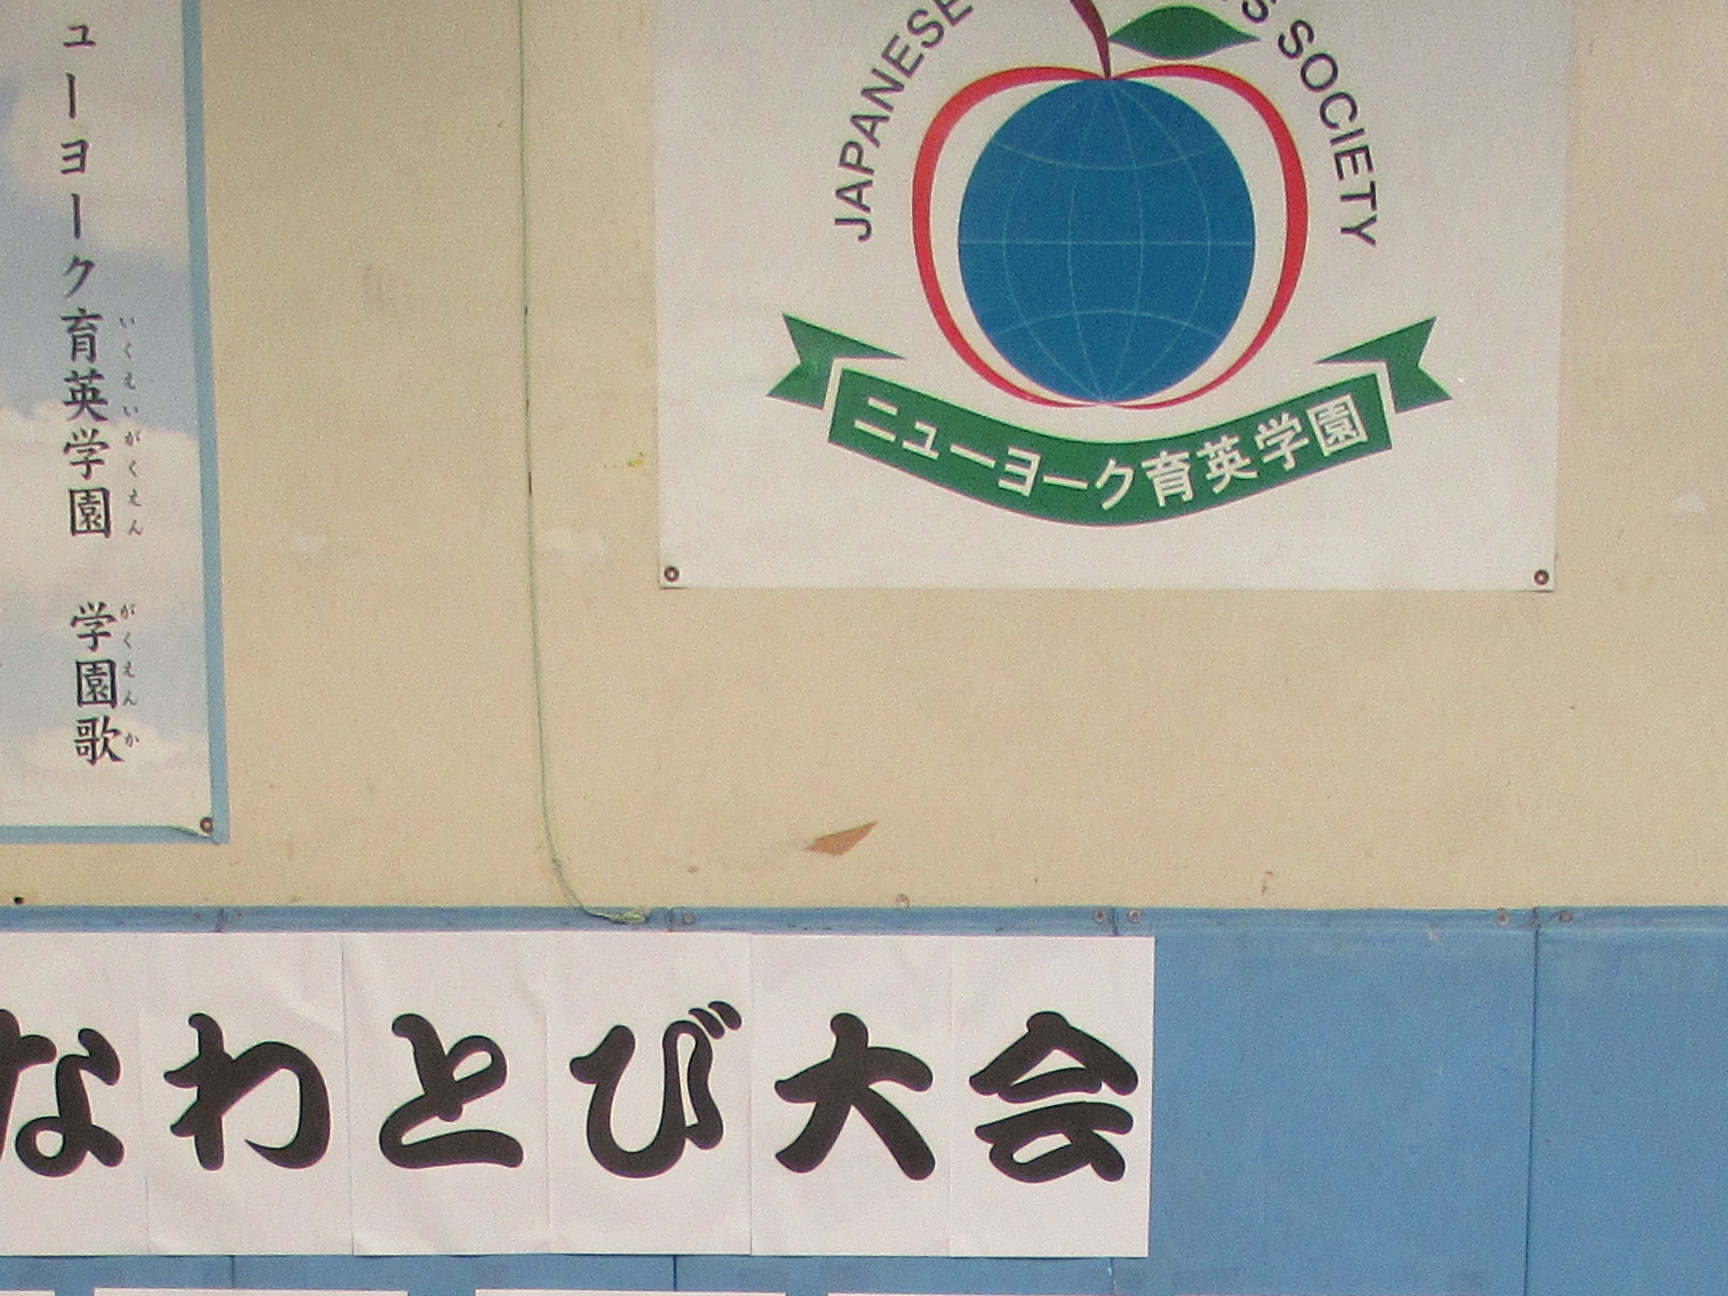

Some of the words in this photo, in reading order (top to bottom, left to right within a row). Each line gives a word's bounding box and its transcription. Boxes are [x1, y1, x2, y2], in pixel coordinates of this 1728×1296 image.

[1278, 19, 1378, 247] SOCIETY
[854, 394, 1368, 512] ニューヨーク育英学園
[72, 603, 122, 765] 学園歌
